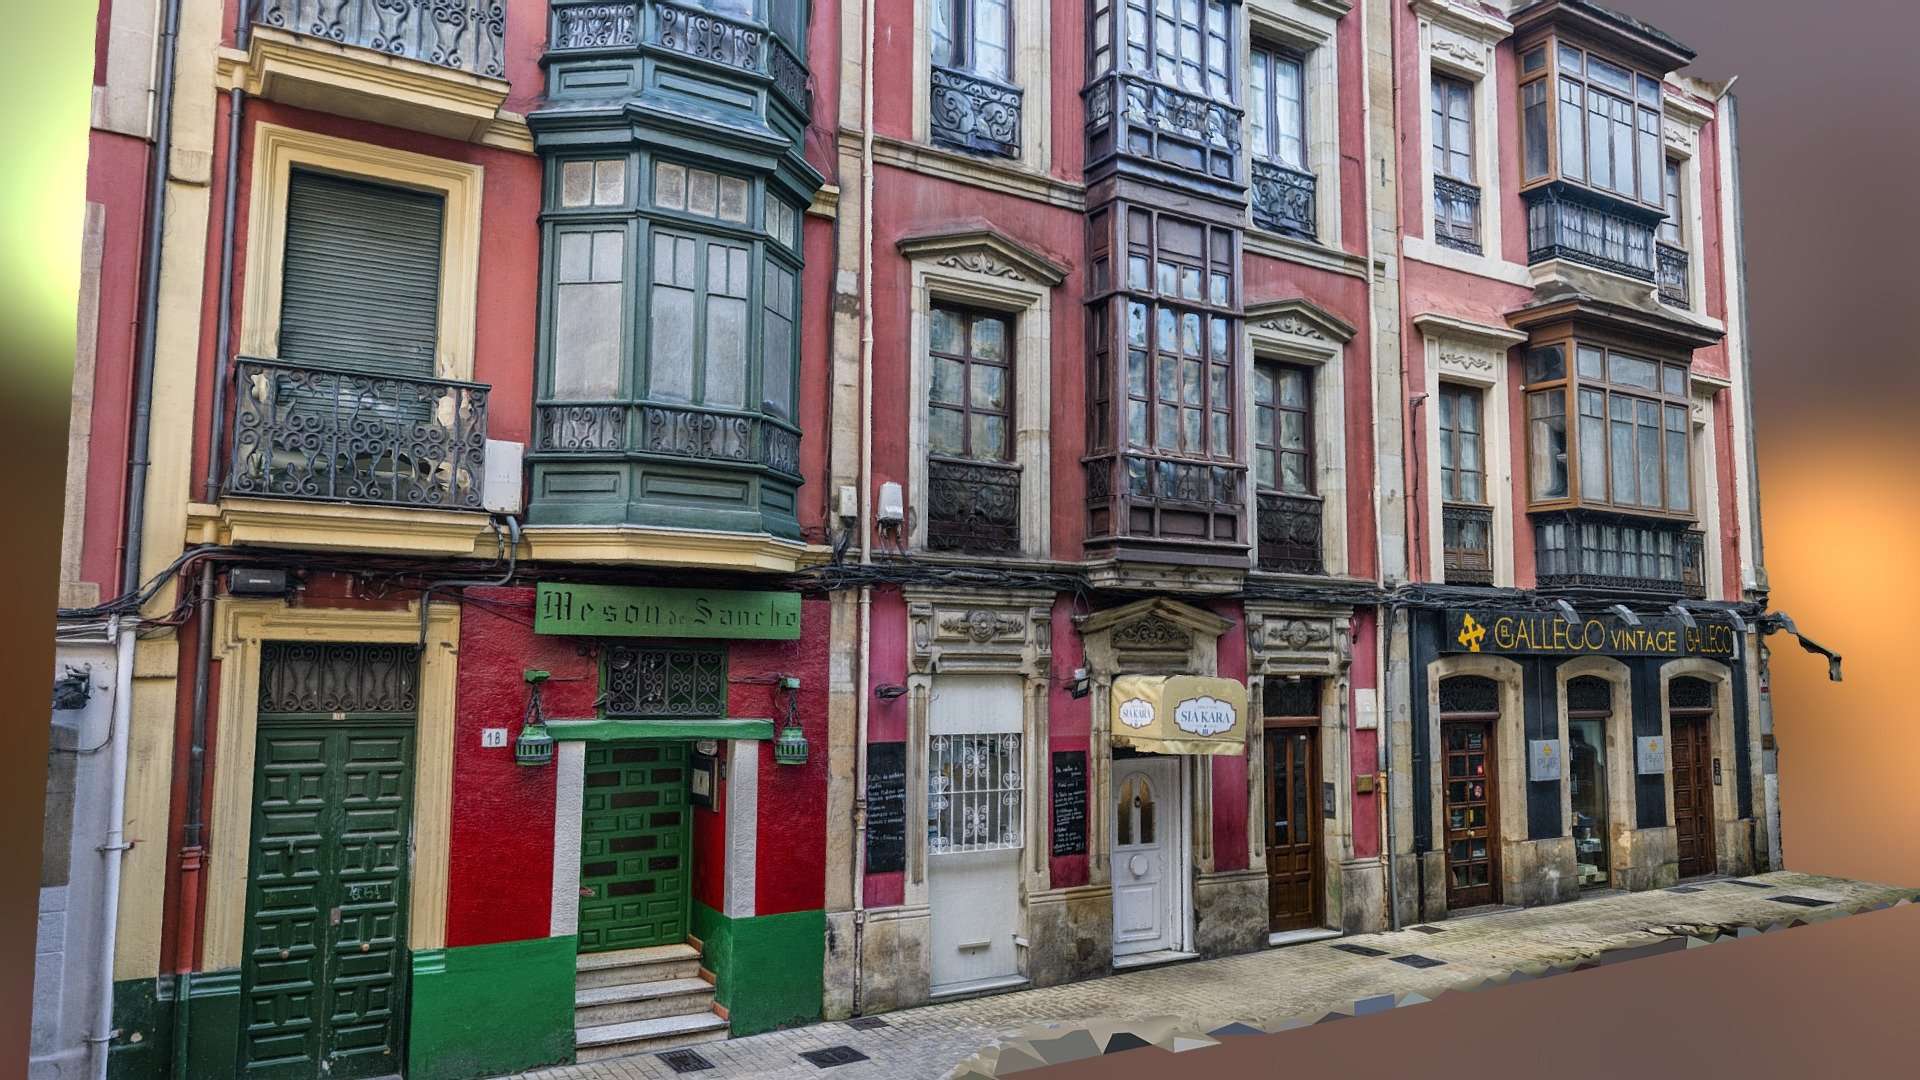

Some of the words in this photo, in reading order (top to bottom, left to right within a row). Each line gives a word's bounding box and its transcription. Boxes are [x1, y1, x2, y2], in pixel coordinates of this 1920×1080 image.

[543, 591, 659, 624] Meson
[694, 597, 796, 627] Sancho
[1610, 630, 1678, 652] VINTAGE
[487, 731, 500, 745] 18
